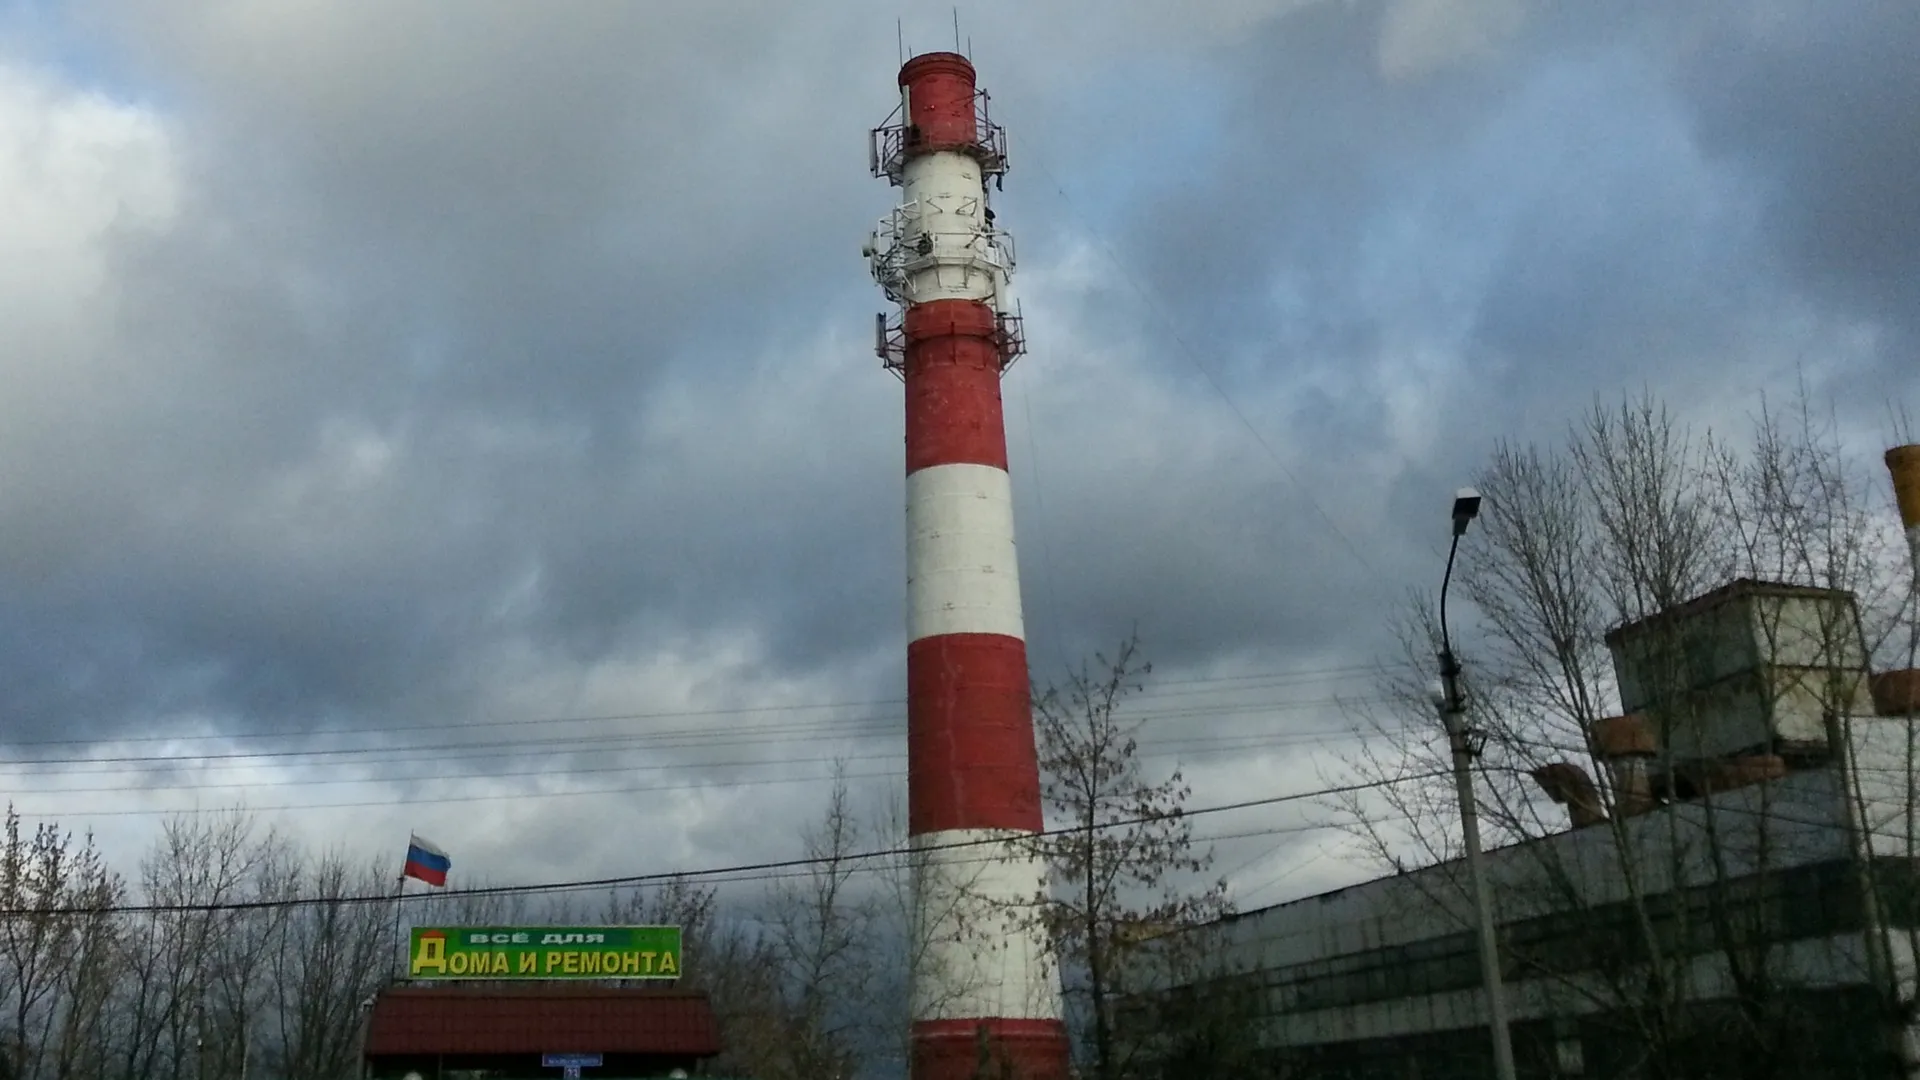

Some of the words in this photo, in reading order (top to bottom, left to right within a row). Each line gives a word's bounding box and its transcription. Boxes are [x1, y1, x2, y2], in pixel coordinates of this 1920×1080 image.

[470, 932, 529, 944] ВСЁ
[541, 933, 605, 945] ДЛЯ
[519, 951, 537, 974] И
[545, 951, 677, 974] РЕМОНТА
